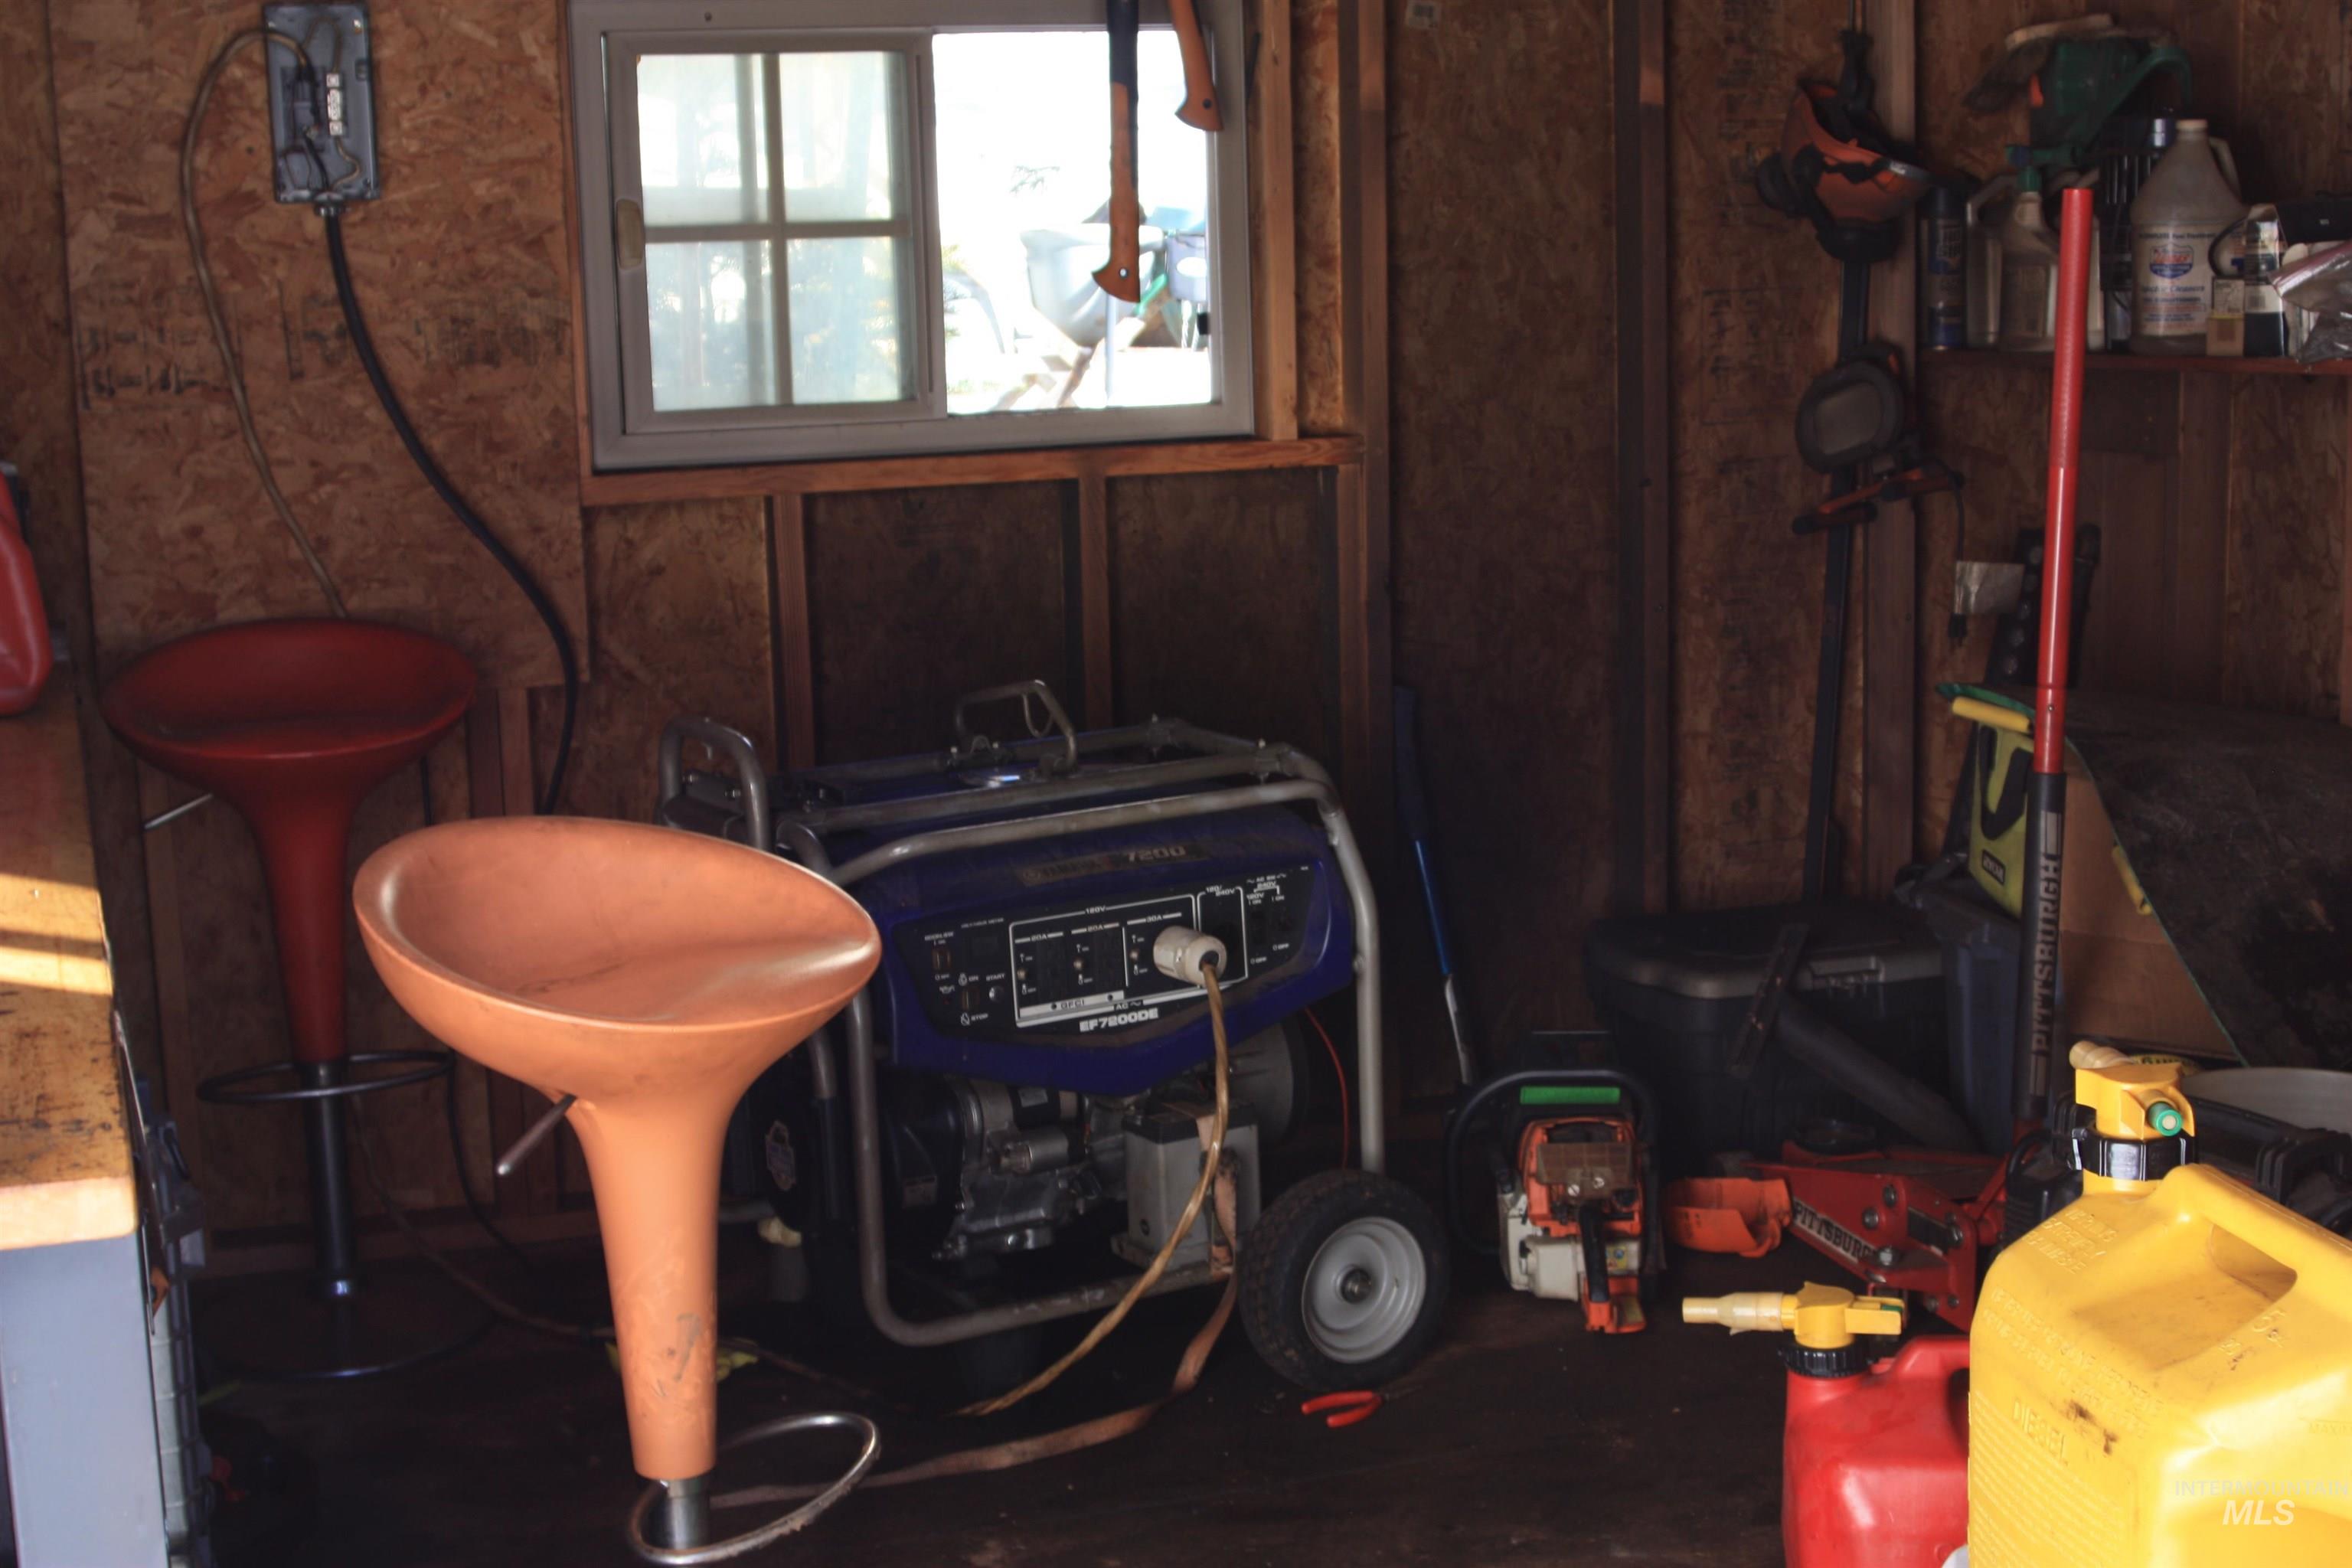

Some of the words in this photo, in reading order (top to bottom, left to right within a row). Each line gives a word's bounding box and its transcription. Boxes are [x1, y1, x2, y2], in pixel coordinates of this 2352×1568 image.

[1127, 845, 1186, 863] 7200
[1084, 905, 1106, 915] 120V
[2031, 858, 2061, 1052] PITTSBURGH
[985, 972, 1005, 982] START
[1116, 1001, 1129, 1011] AC
[971, 1013, 989, 1021] STOP
[1080, 1007, 1159, 1033] EF7200DE
[2014, 1400, 2069, 1465] DIESEL
